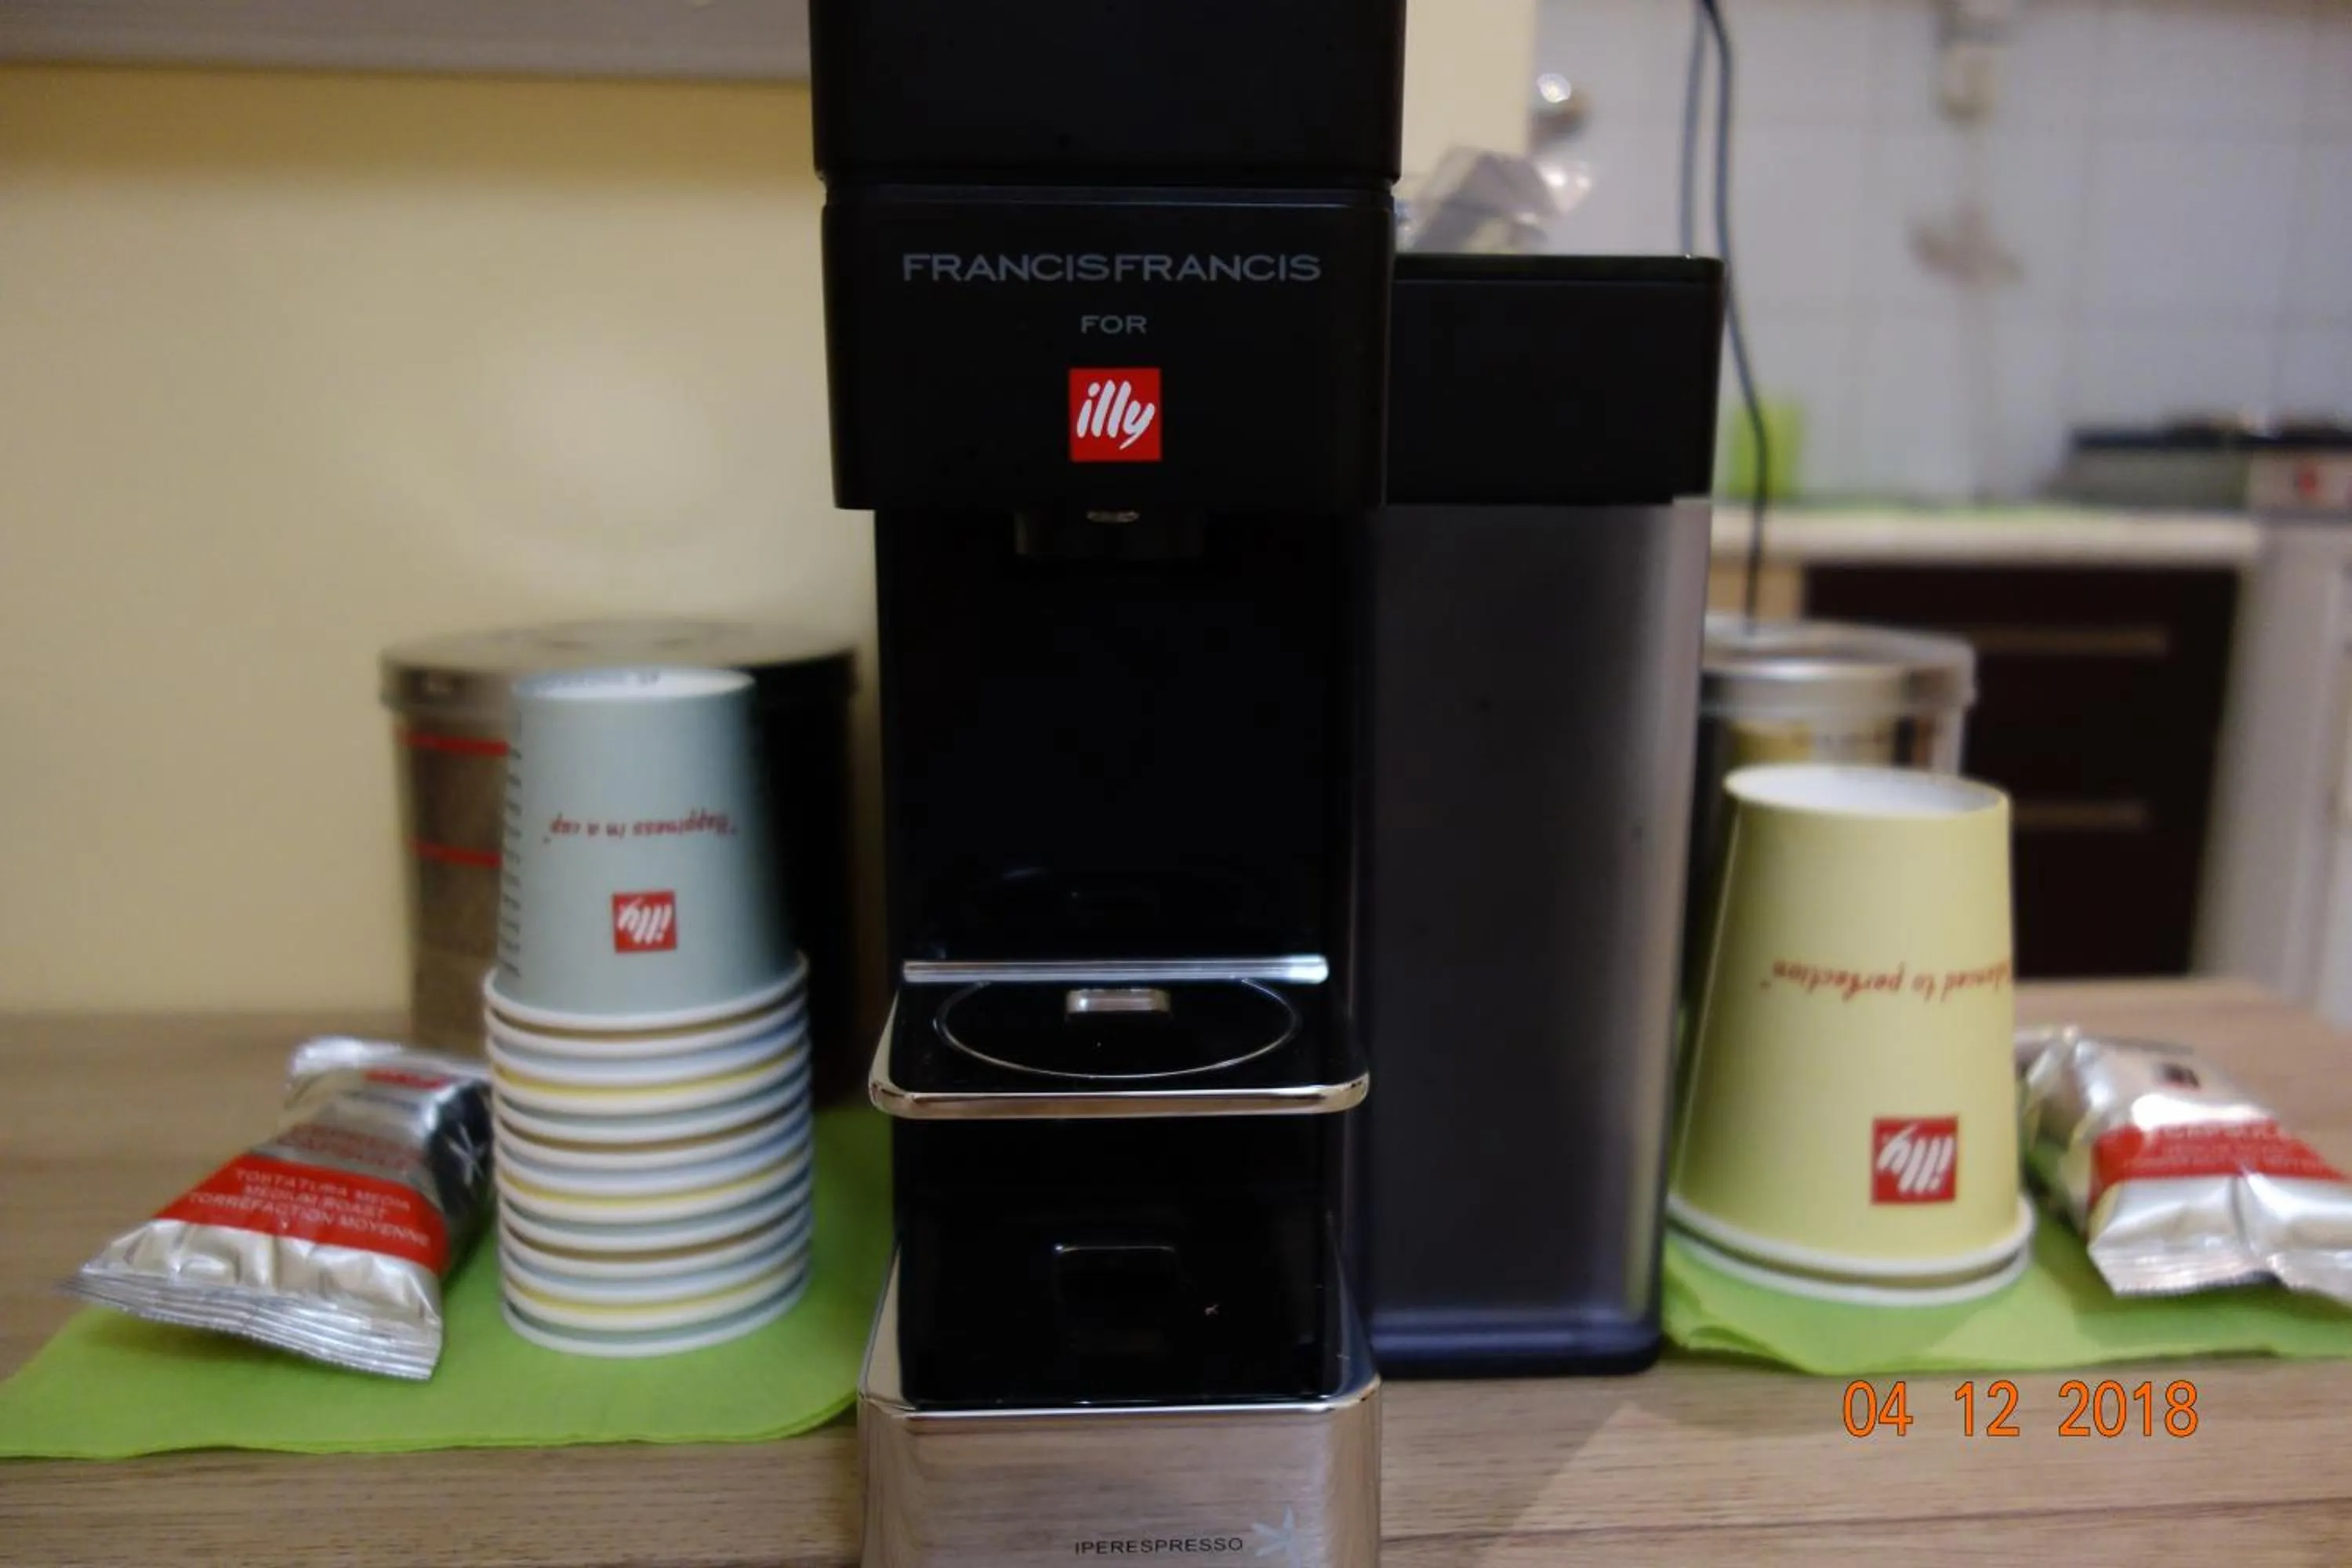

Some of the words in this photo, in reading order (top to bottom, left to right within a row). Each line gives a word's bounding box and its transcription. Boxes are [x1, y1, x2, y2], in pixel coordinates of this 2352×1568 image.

[902, 253, 1322, 282] FRANCISFRANCIS
[1080, 314, 1147, 334] FOR
[1076, 379, 1156, 449] illy
[588, 822, 600, 837] a
[605, 822, 626, 839] in
[617, 897, 673, 944] illy
[1911, 974, 1936, 1004] to
[1876, 1122, 1954, 1194] illy
[237, 1168, 348, 1197] TOSTATURA
[354, 1189, 411, 1212] MEDIA
[1075, 1537, 1243, 1555] IPERESPRESSO
